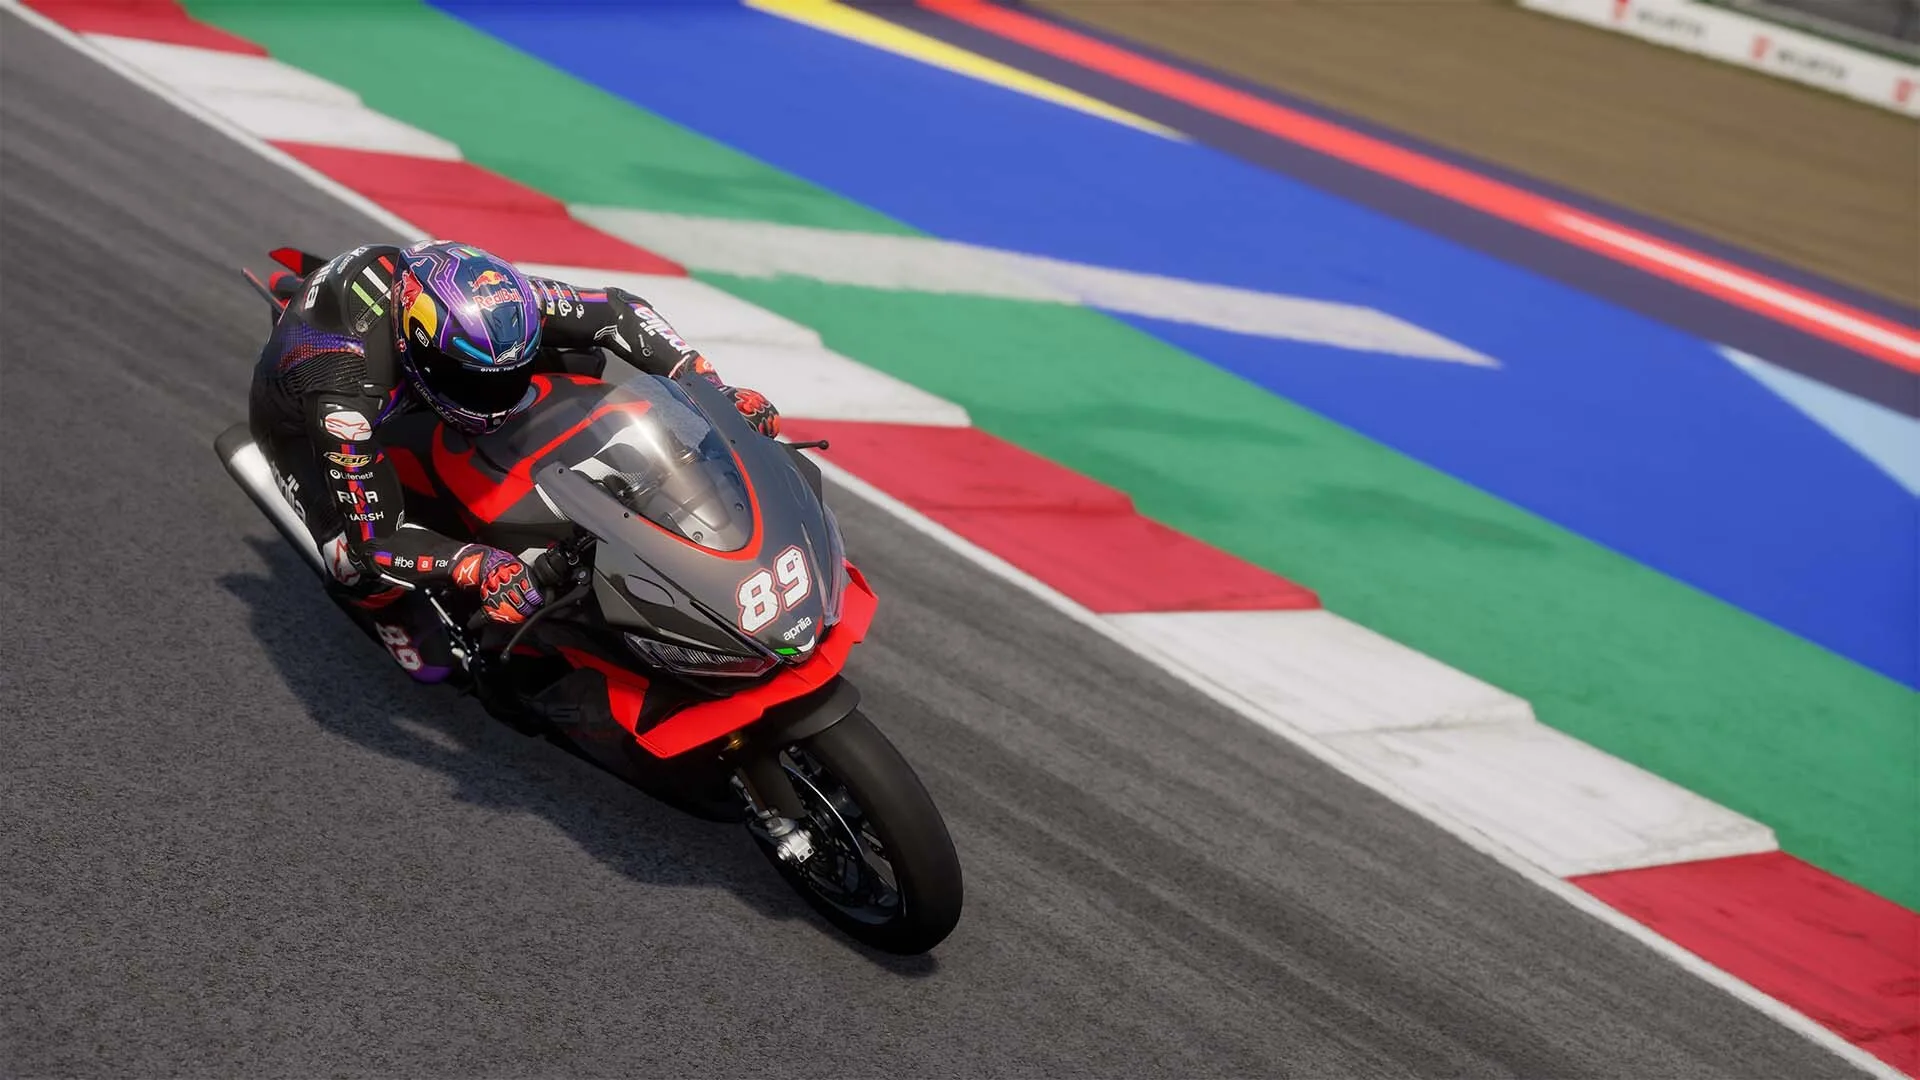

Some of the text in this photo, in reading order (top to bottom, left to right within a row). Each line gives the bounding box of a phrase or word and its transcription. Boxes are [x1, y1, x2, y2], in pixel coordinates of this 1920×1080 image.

[394, 556, 415, 569] #be
[736, 544, 813, 636] 89
[783, 616, 812, 641] aprilia
